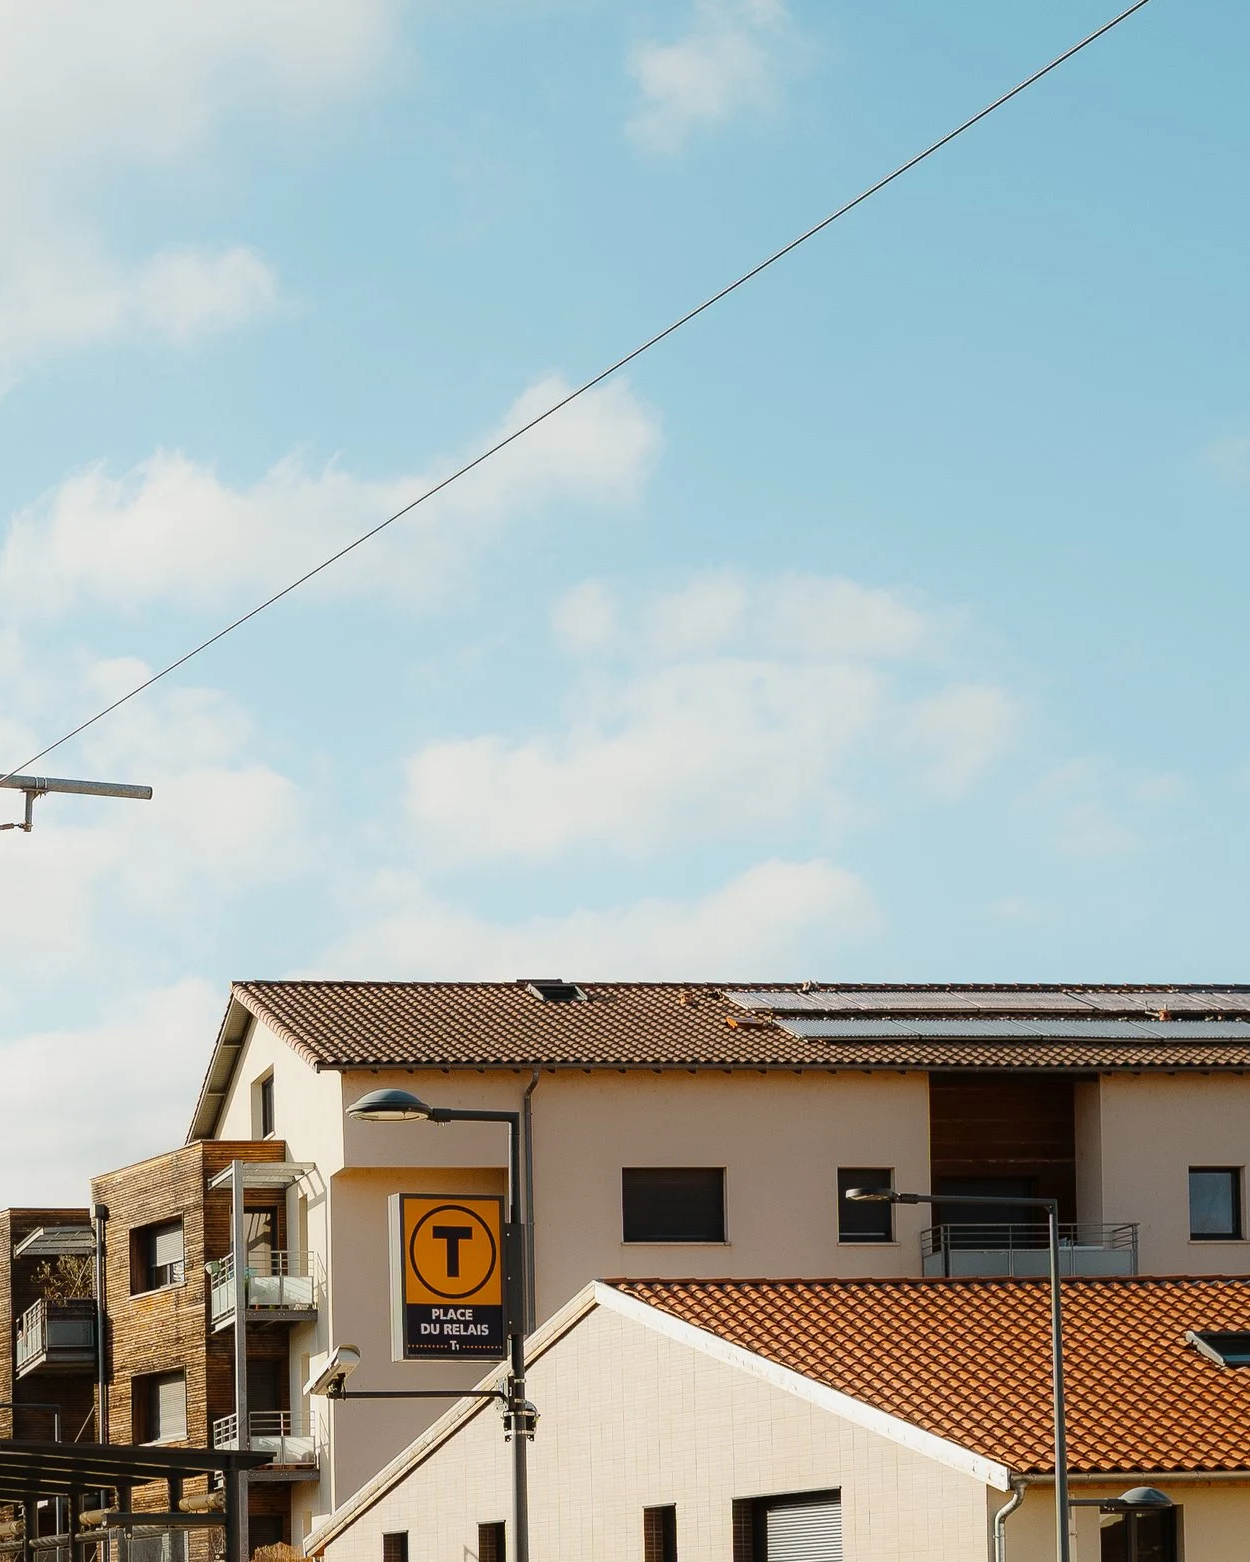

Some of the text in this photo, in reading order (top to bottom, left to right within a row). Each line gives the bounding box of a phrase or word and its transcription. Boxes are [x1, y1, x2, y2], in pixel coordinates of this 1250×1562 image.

[432, 1225, 473, 1278] T
[431, 1308, 473, 1320] PLACE
[420, 1323, 489, 1336] DU RELAIS
[449, 1340, 460, 1351] T1
